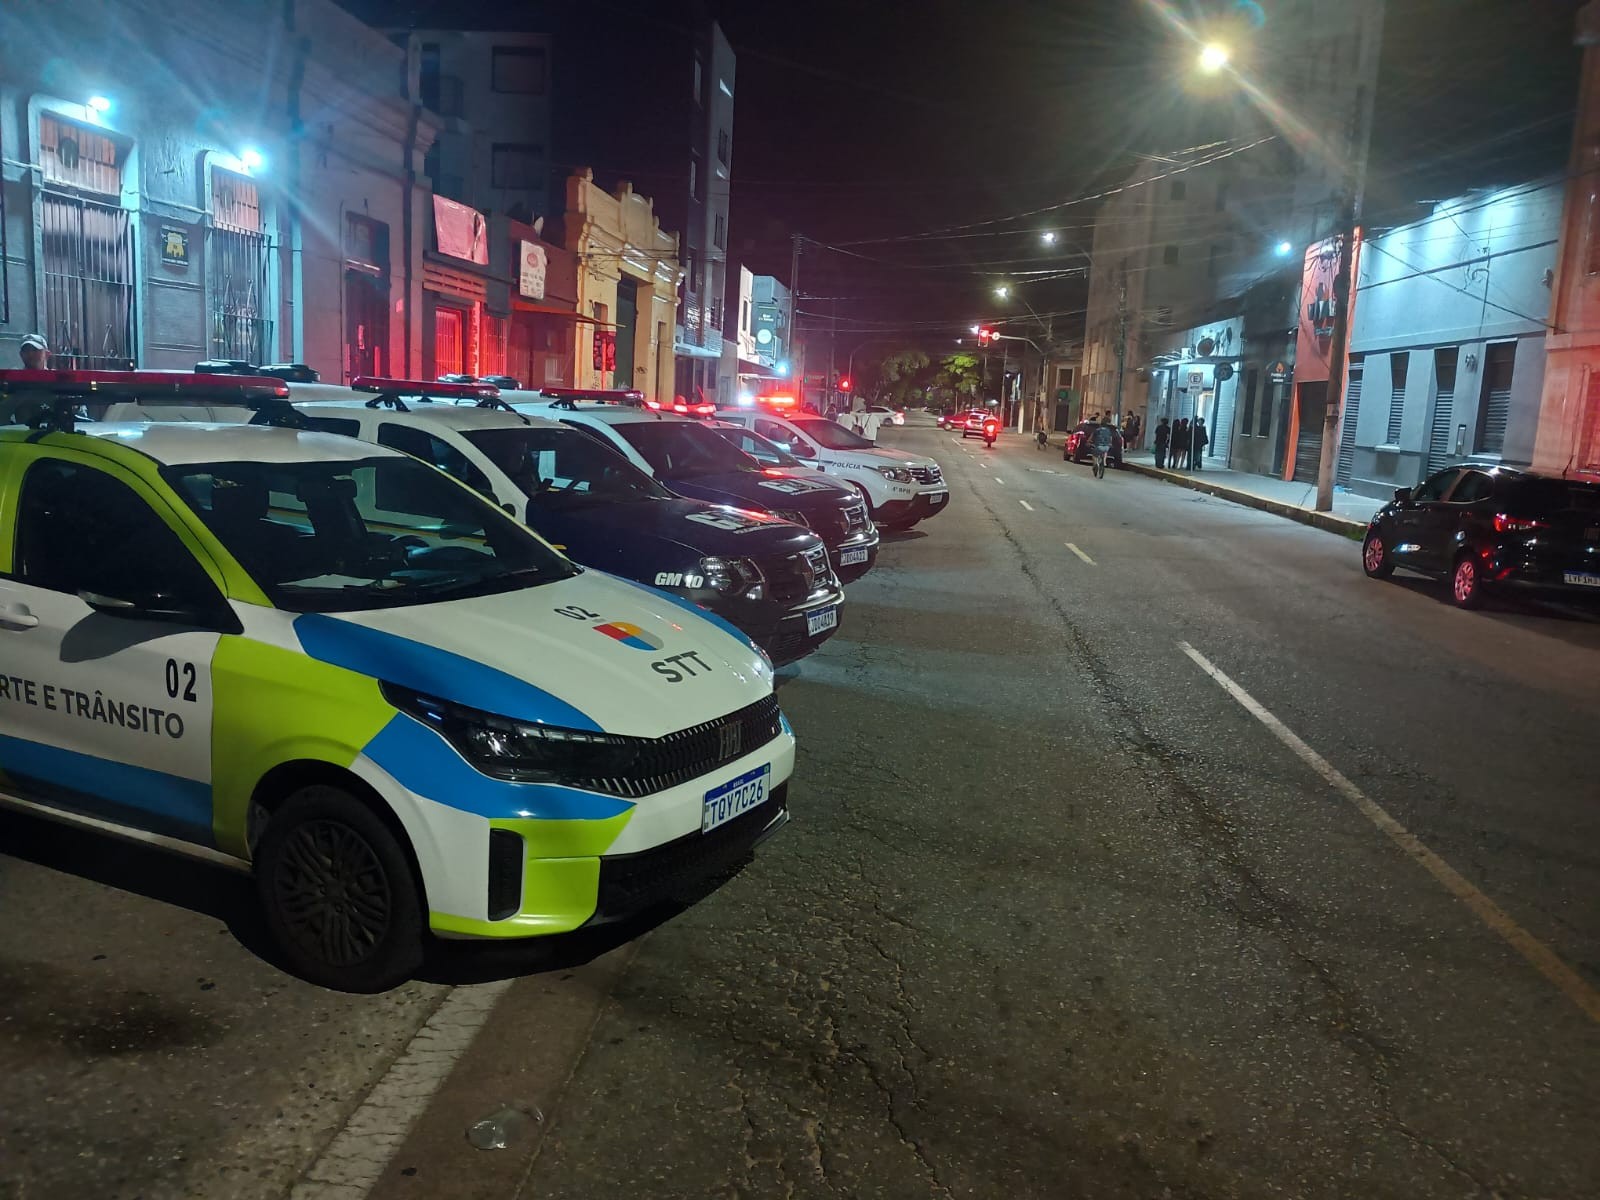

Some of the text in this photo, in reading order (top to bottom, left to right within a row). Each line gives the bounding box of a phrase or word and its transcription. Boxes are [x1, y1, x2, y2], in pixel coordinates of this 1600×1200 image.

[832, 461, 861, 470] POLÍCIA
[655, 572, 704, 588] GM 10
[553, 605, 601, 621] 02
[165, 658, 197, 702] 02
[651, 650, 713, 683] STT
[43, 684, 57, 711] E
[59, 688, 185, 739] TRÂNSITO
[711, 779, 763, 825] TQY7C26
